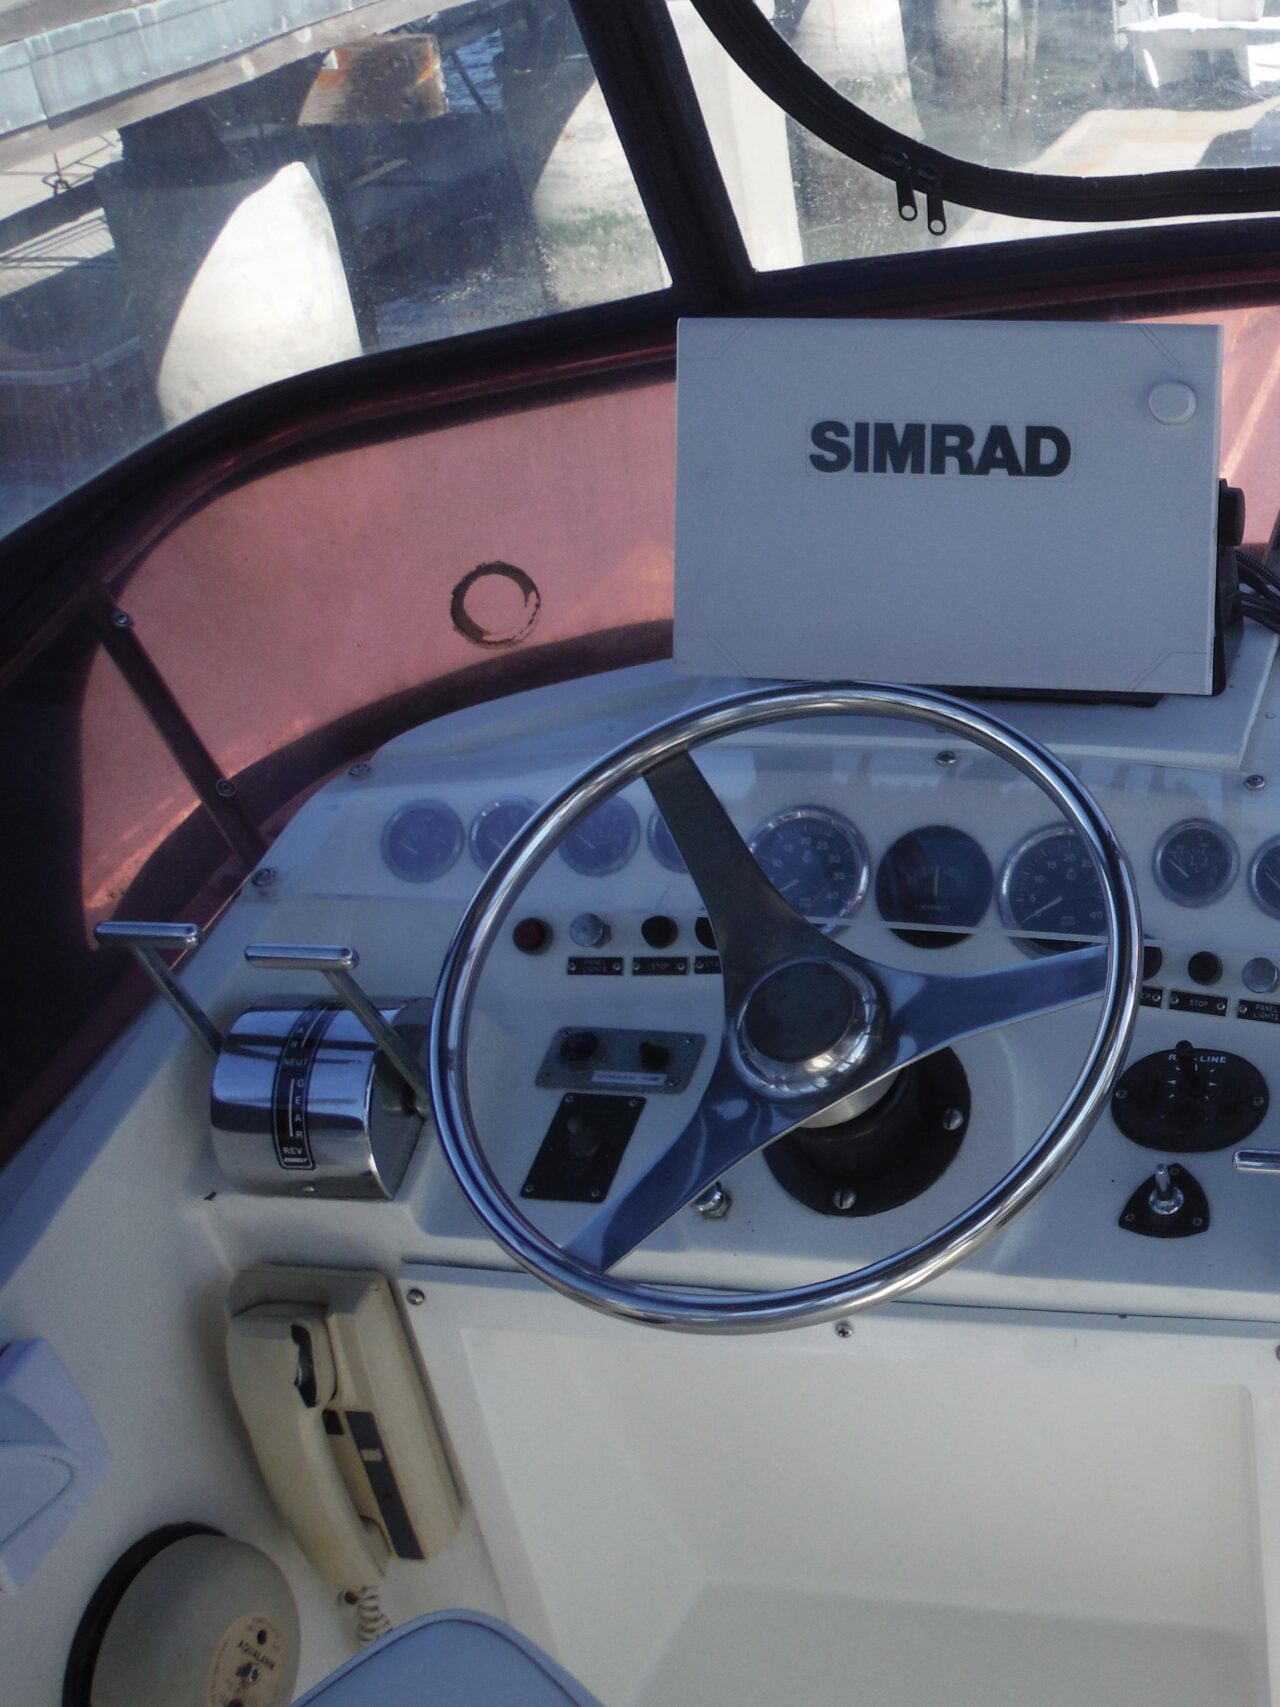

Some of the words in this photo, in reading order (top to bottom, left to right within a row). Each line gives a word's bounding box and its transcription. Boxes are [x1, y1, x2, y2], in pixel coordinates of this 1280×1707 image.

[809, 420, 1072, 477] SIMRAD
[800, 836, 812, 845] 20
[829, 855, 841, 864] 30
[1063, 854, 1076, 862] 20
[1047, 862, 1056, 870] 15
[833, 872, 845, 881] 35
[826, 891, 839, 900] 40
[1030, 894, 1037, 903] 5
[1090, 911, 1103, 920] 40
[1189, 999, 1209, 1008] STOP
[1255, 1003, 1280, 1013] PANEL
[1253, 1012, 1280, 1021] LIGHTS
[284, 1058, 309, 1066] NEUT
[295, 1079, 304, 1139] GEAR
[283, 1147, 303, 1155] REV
